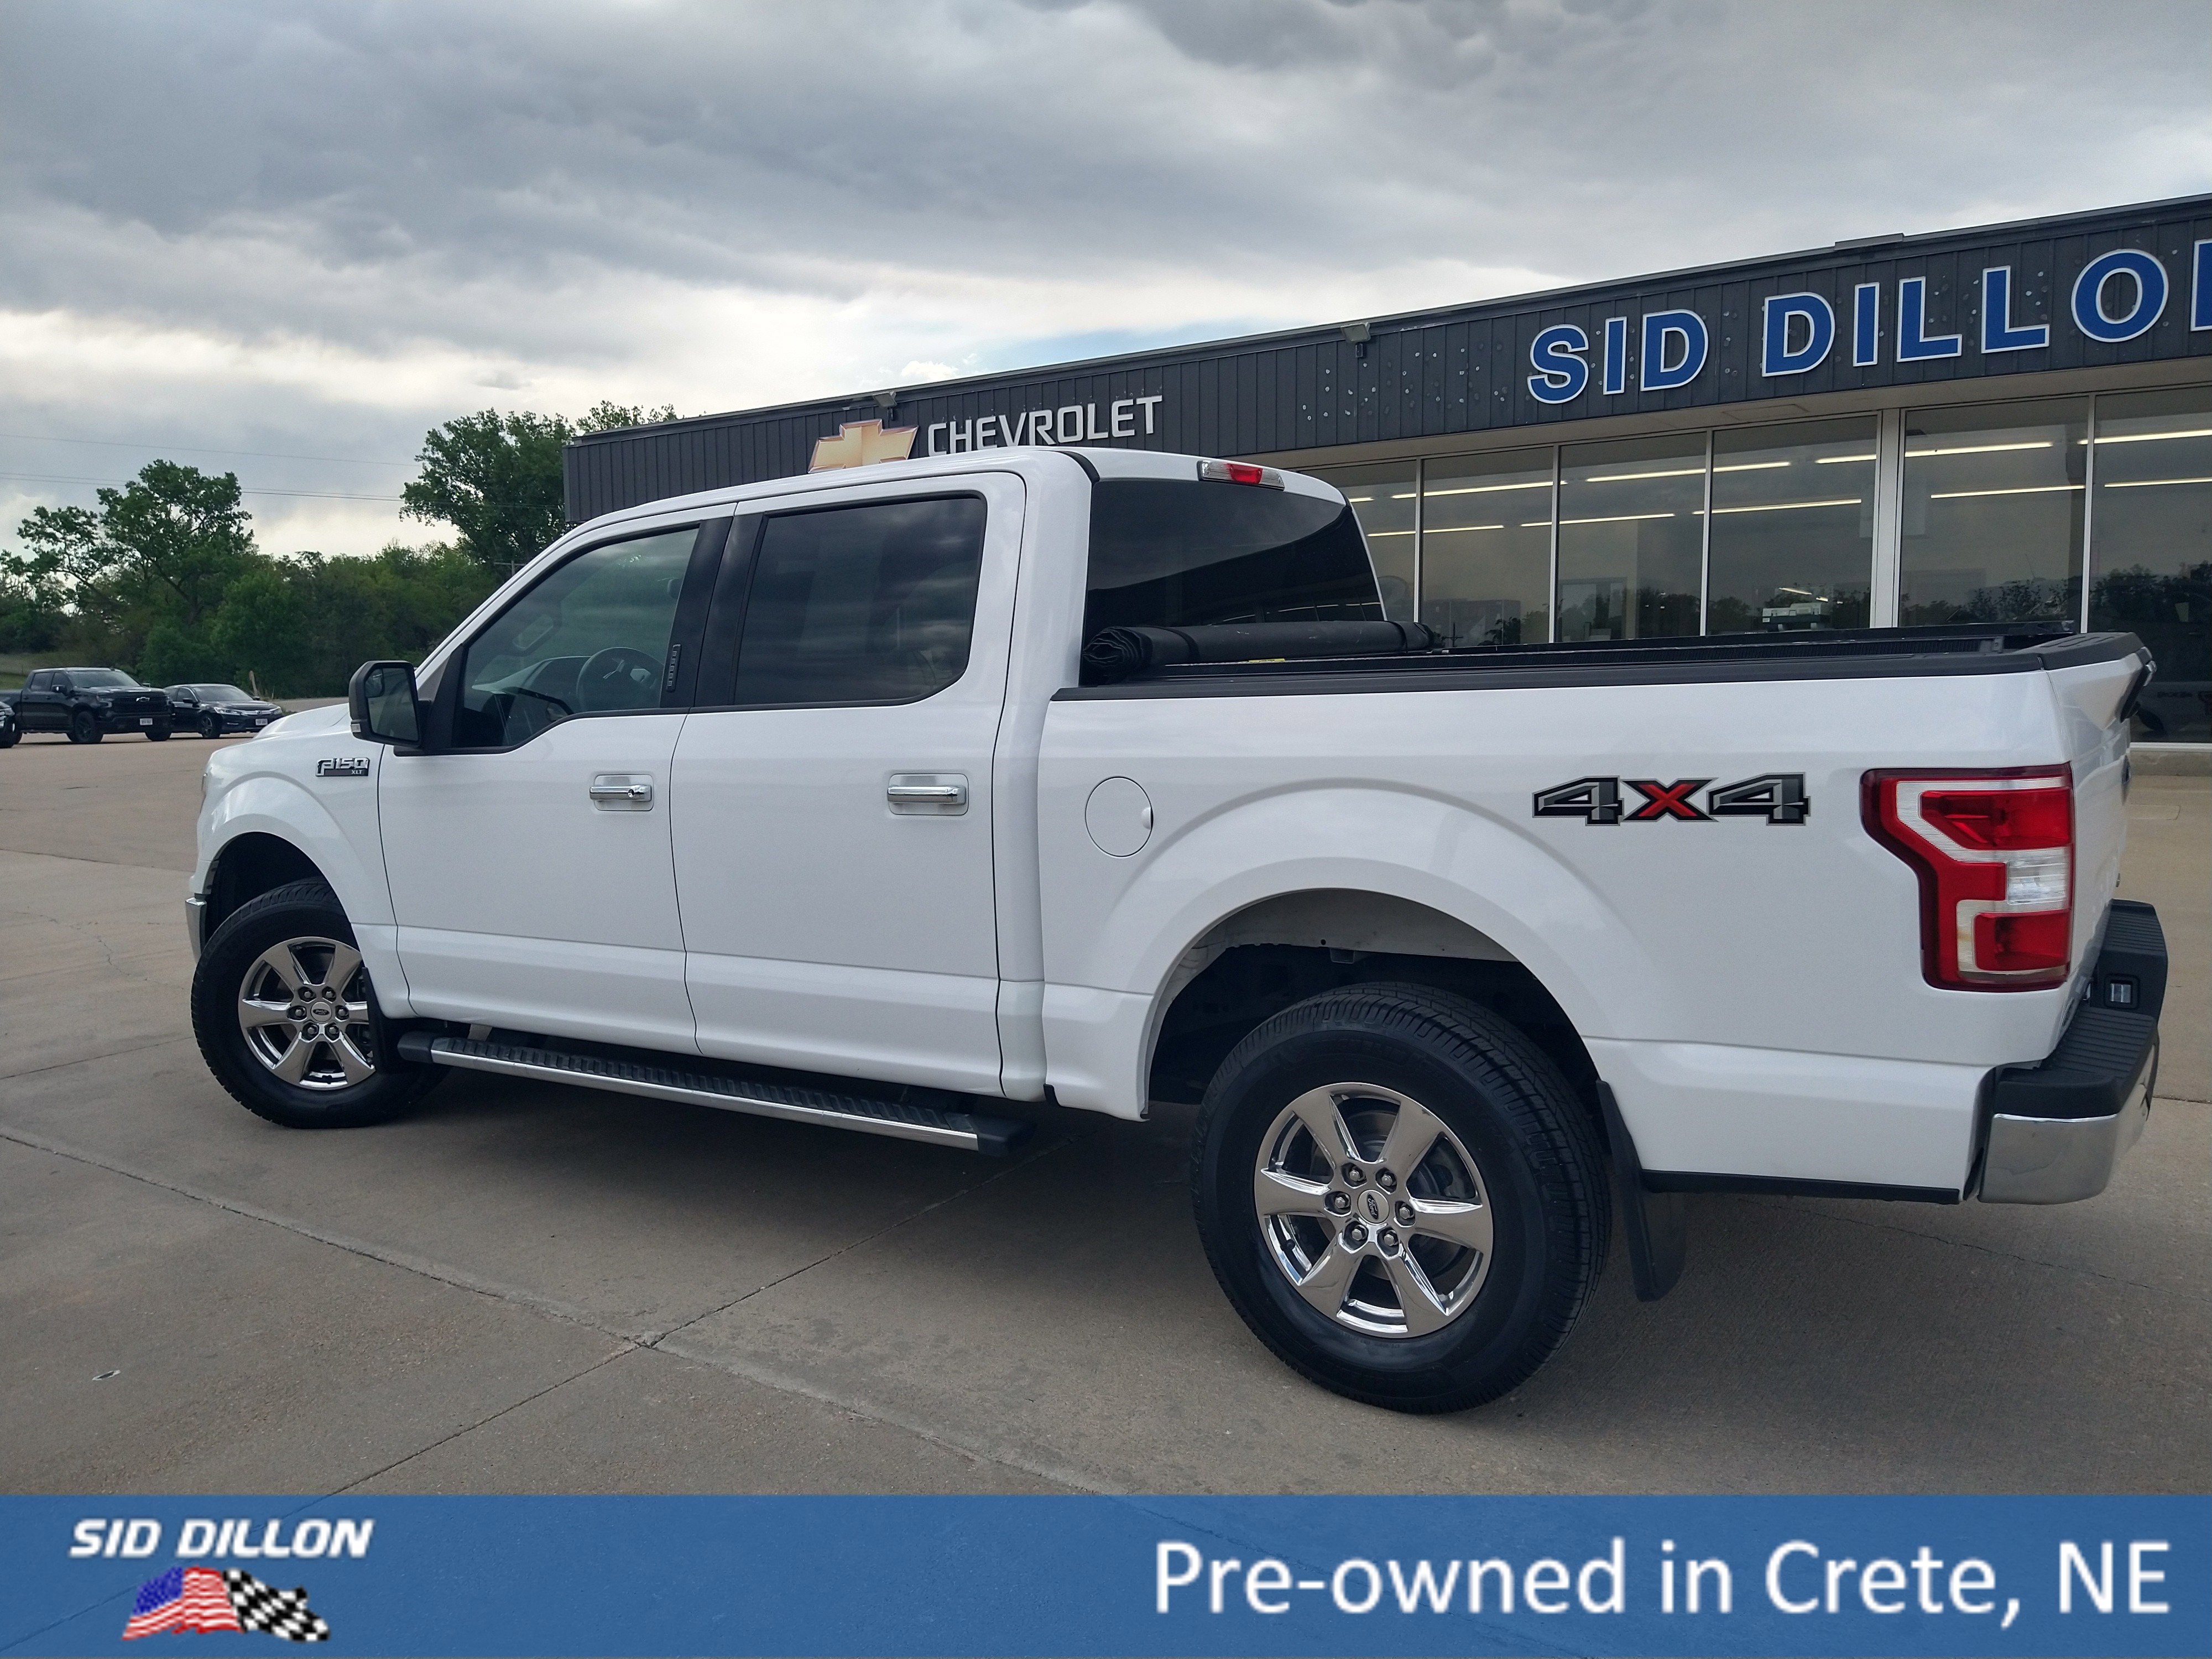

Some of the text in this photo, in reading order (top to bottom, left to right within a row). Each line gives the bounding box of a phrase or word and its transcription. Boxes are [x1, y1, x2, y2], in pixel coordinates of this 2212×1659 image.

[1527, 309, 1709, 404] SID
[927, 395, 1162, 457] CHEVROLET
[1368, 1197, 1378, 1217] Ford
